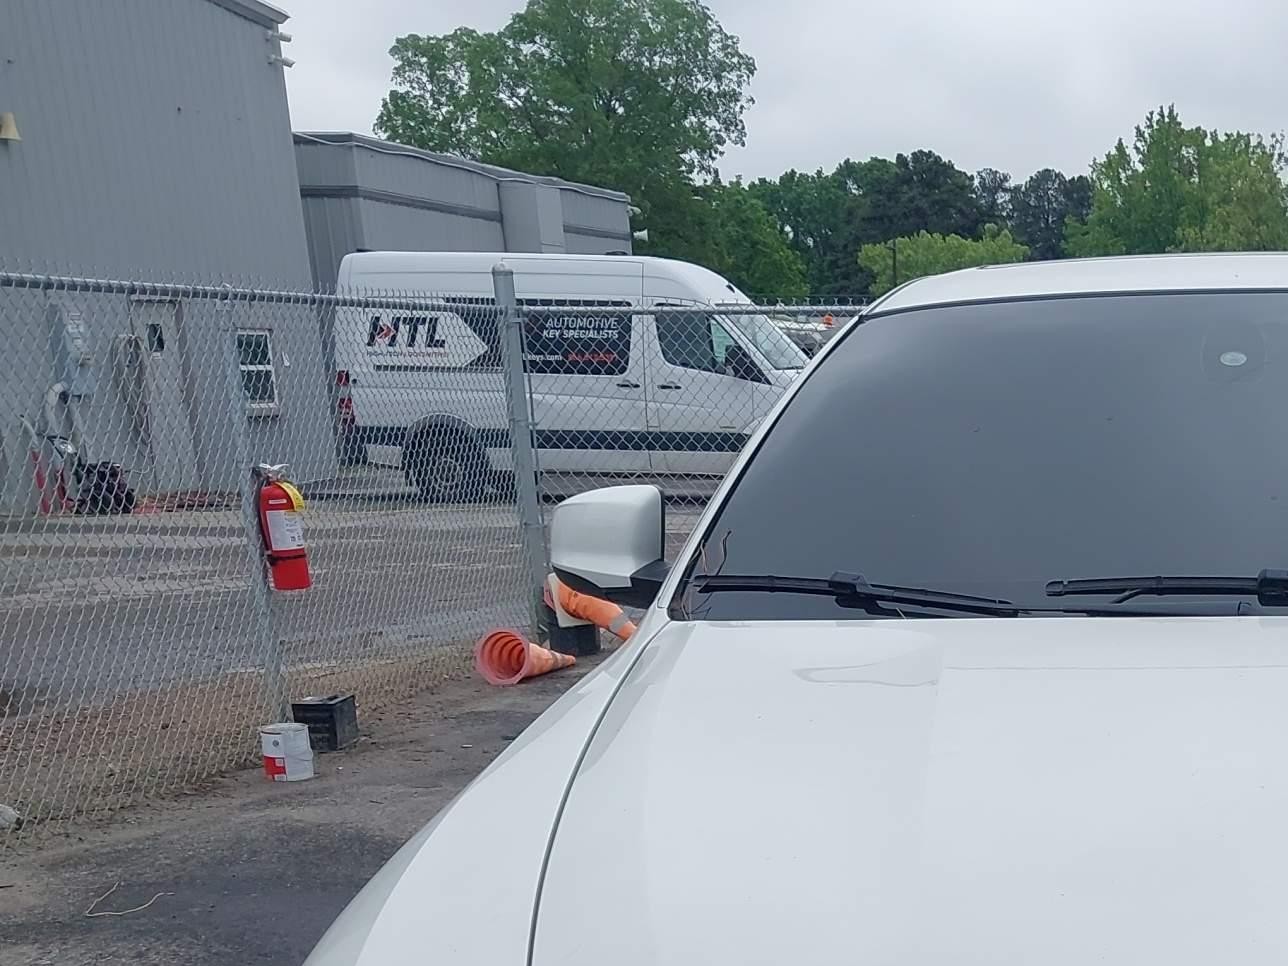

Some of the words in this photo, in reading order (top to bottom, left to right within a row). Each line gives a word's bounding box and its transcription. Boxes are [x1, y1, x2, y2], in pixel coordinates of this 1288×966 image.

[546, 317, 619, 329] AUTOMOTIVE
[543, 329, 561, 339] KEY
[562, 329, 619, 339] SPECIALISTS
